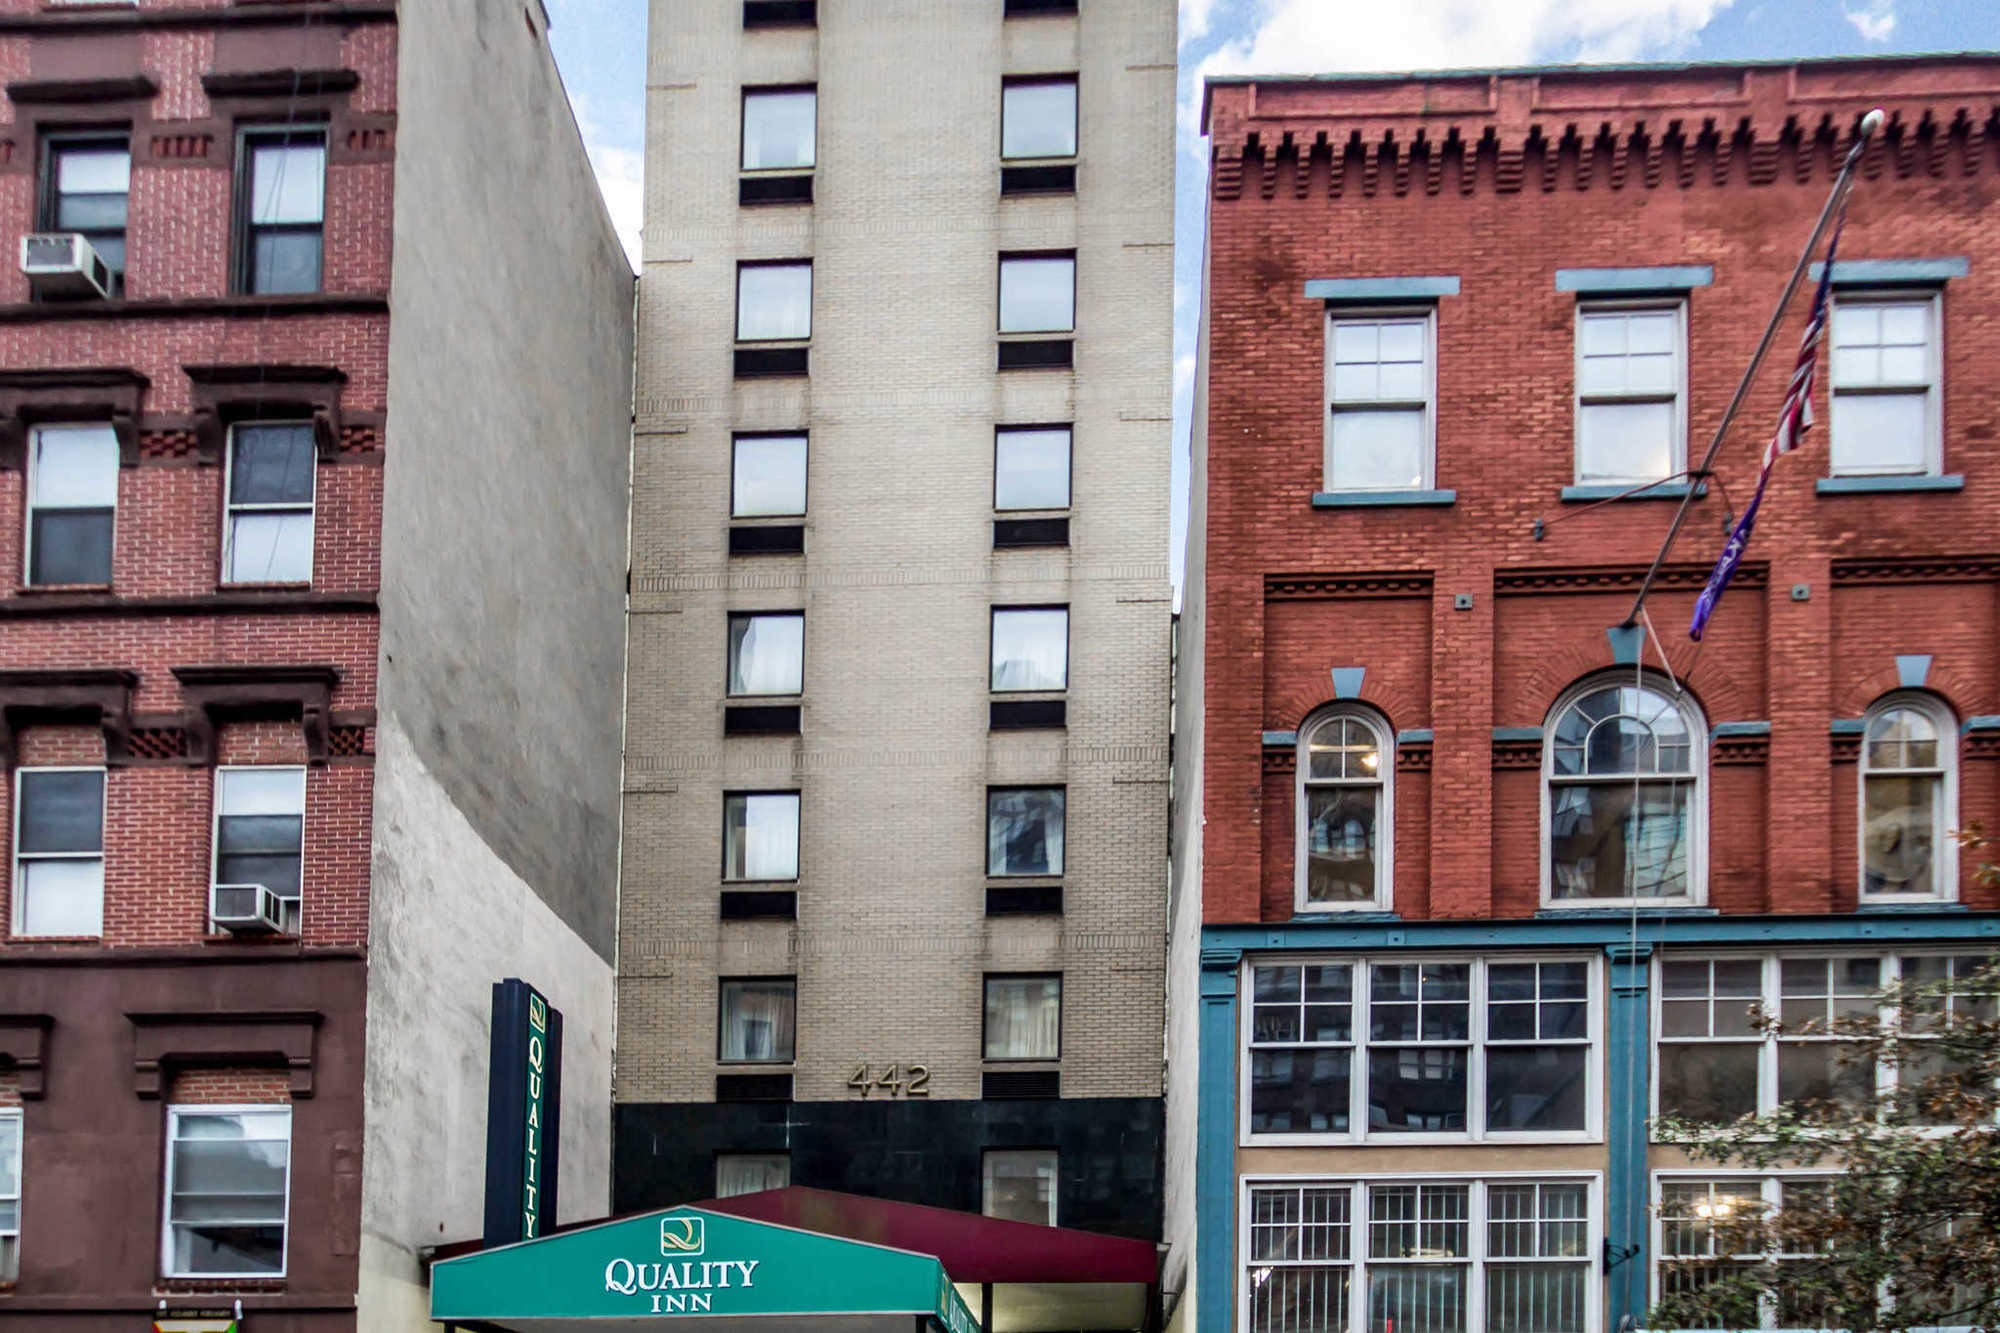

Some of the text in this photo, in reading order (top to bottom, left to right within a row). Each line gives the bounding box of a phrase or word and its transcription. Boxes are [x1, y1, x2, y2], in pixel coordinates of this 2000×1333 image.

[847, 1064, 930, 1097] 442
[524, 1036, 543, 1238] QUALITY
[605, 1258, 760, 1296] QUALITY
[651, 1293, 713, 1313] INN
